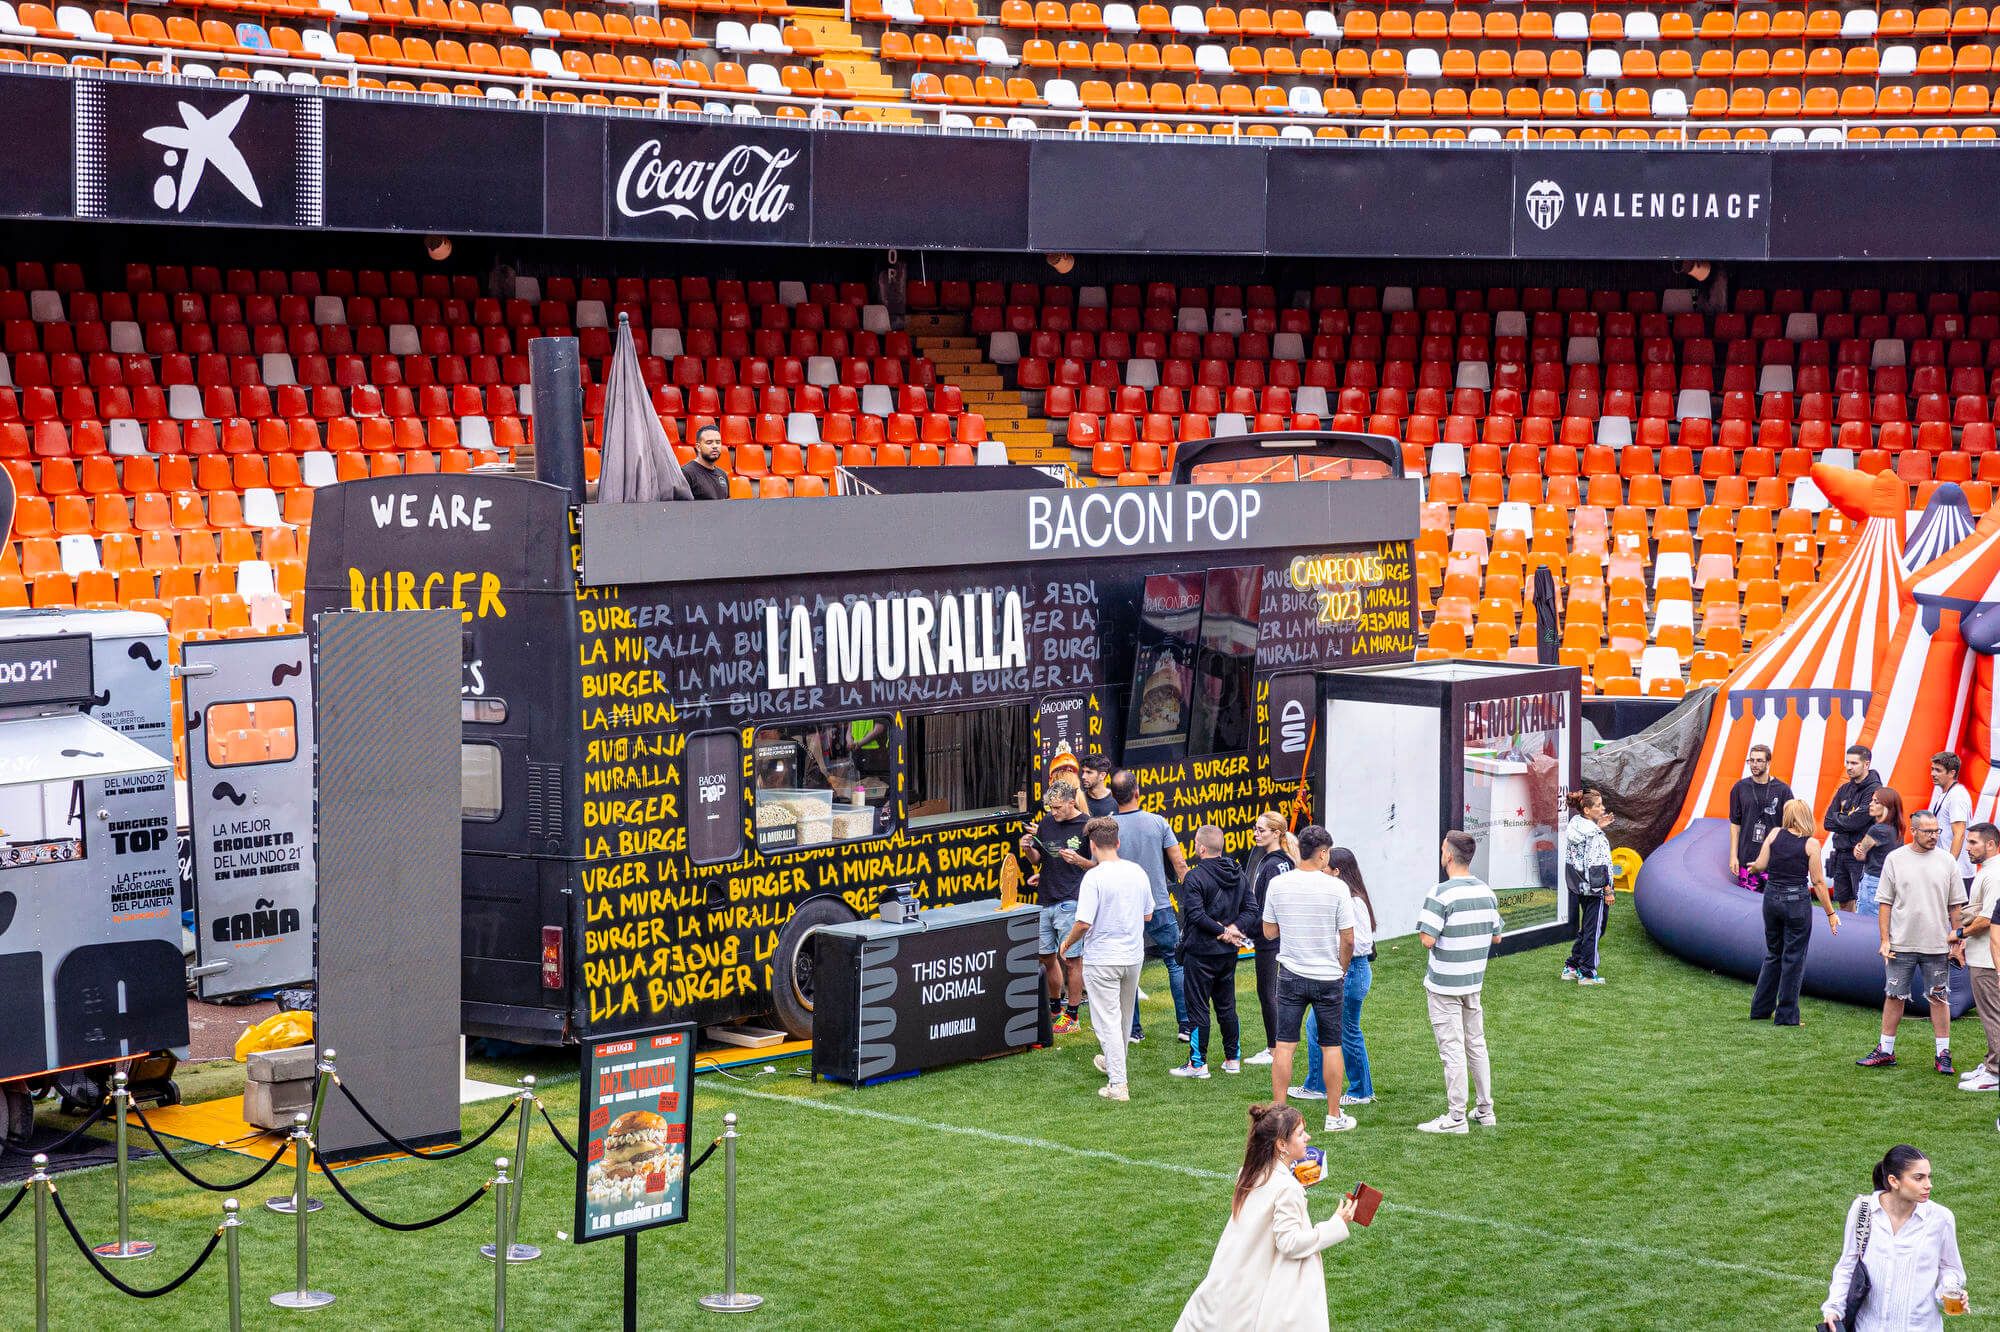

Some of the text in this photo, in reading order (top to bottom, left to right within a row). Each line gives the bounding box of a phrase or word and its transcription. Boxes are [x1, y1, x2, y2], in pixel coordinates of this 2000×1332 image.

[820, 25, 827, 35] 4
[881, 107, 887, 117] 2
[616, 139, 801, 222] Coca-Cola
[987, 392, 994, 401] 17
[1011, 420, 1019, 430] 16
[1034, 449, 1042, 459] 15
[370, 493, 492, 531] WE ARE
[1029, 489, 1261, 550] BACON POP
[1294, 556, 1384, 588] CAMPEONES
[348, 567, 506, 623] BURGER
[1319, 591, 1361, 623] 2023
[579, 604, 673, 633] BURGER
[685, 604, 709, 625] LA
[1286, 619, 1302, 638] LA
[580, 638, 608, 665] LA
[615, 631, 721, 664] MURALLA
[765, 590, 1027, 690] LA MURALLA
[1257, 640, 1318, 665] MURALLA
[1352, 634, 1367, 655] LA
[581, 670, 670, 699] BURGER
[679, 667, 702, 690] LA
[583, 706, 609, 731] LA
[729, 687, 825, 716] BURGER
[840, 686, 863, 706] LA
[871, 677, 963, 704] MURALLA
[971, 665, 1064, 693] BURGER
[1073, 663, 1094, 684] LA
[1041, 699, 1083, 715] BACONPOP
[1464, 691, 1566, 741] LA MURALLA
[104, 778, 121, 788] DEL
[123, 775, 155, 786] MUNDO
[585, 763, 681, 794] MURALLA
[698, 773, 727, 786] BACON
[1193, 755, 1250, 781] BURGER
[108, 816, 168, 832] BURGUERS
[583, 793, 679, 828] BURGER
[1188, 813, 1203, 832] LA
[212, 818, 271, 837] LA MEJOR
[110, 828, 168, 855] TOP
[213, 831, 294, 853] CROQUETA
[585, 836, 612, 860] LA
[214, 854, 237, 870] DEL
[240, 848, 286, 866] MUNDO
[214, 862, 300, 881] EN UNA BURGER
[658, 858, 679, 882] LA
[111, 877, 173, 894] MEJOR CARNE
[117, 873, 130, 884] LA
[586, 896, 614, 922] LA
[729, 867, 811, 902] BURGER
[819, 864, 839, 887] LA
[843, 851, 932, 884] MURALLA
[111, 886, 175, 903] MADURADA
[112, 898, 173, 912] DEL PLANETA
[212, 898, 300, 942] CAÑA
[585, 917, 670, 954] BURGER
[678, 915, 702, 939] LA
[707, 901, 797, 933] MURALLA
[583, 952, 648, 988] RALLA
[912, 949, 997, 983] THIS IS NOT
[590, 982, 639, 1023] LLA
[647, 964, 758, 1014] BURGER
[922, 976, 985, 1005] NORMAL
[929, 1017, 977, 1040] LA MURALLA
[600, 1072, 625, 1095] DEL
[628, 1063, 676, 1090] MUNDO
